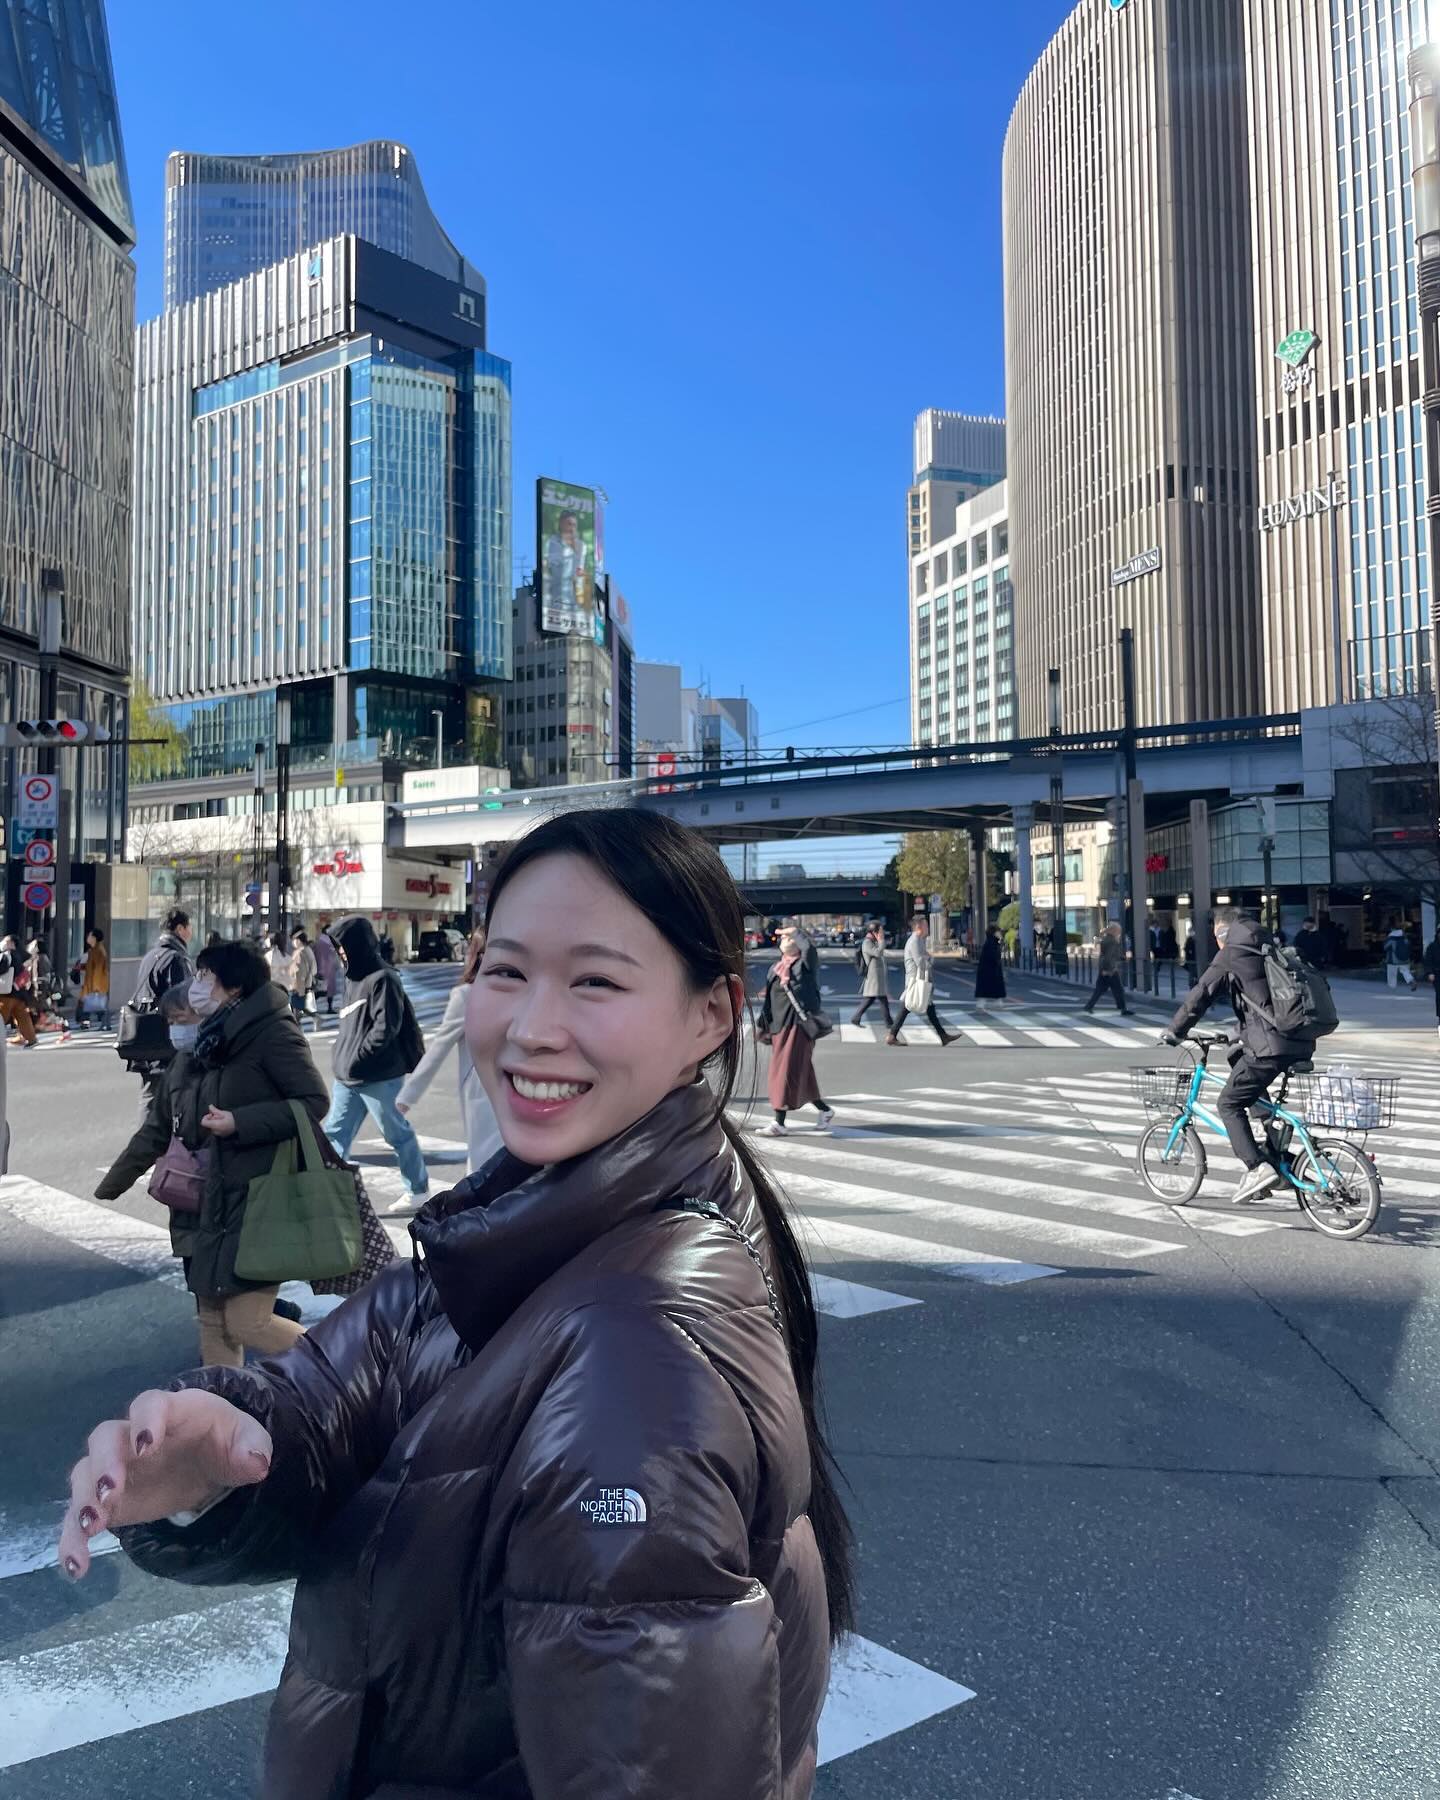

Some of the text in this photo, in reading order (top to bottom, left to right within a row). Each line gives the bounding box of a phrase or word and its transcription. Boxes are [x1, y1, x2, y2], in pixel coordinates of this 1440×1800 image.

[1281, 364, 1315, 393] 松竹
[1258, 472, 1346, 531] LUMINE
[1129, 551, 1157, 573] MENS
[600, 1488, 623, 1500] THE
[580, 1500, 623, 1512] NORTH
[592, 1512, 623, 1523] FACE
